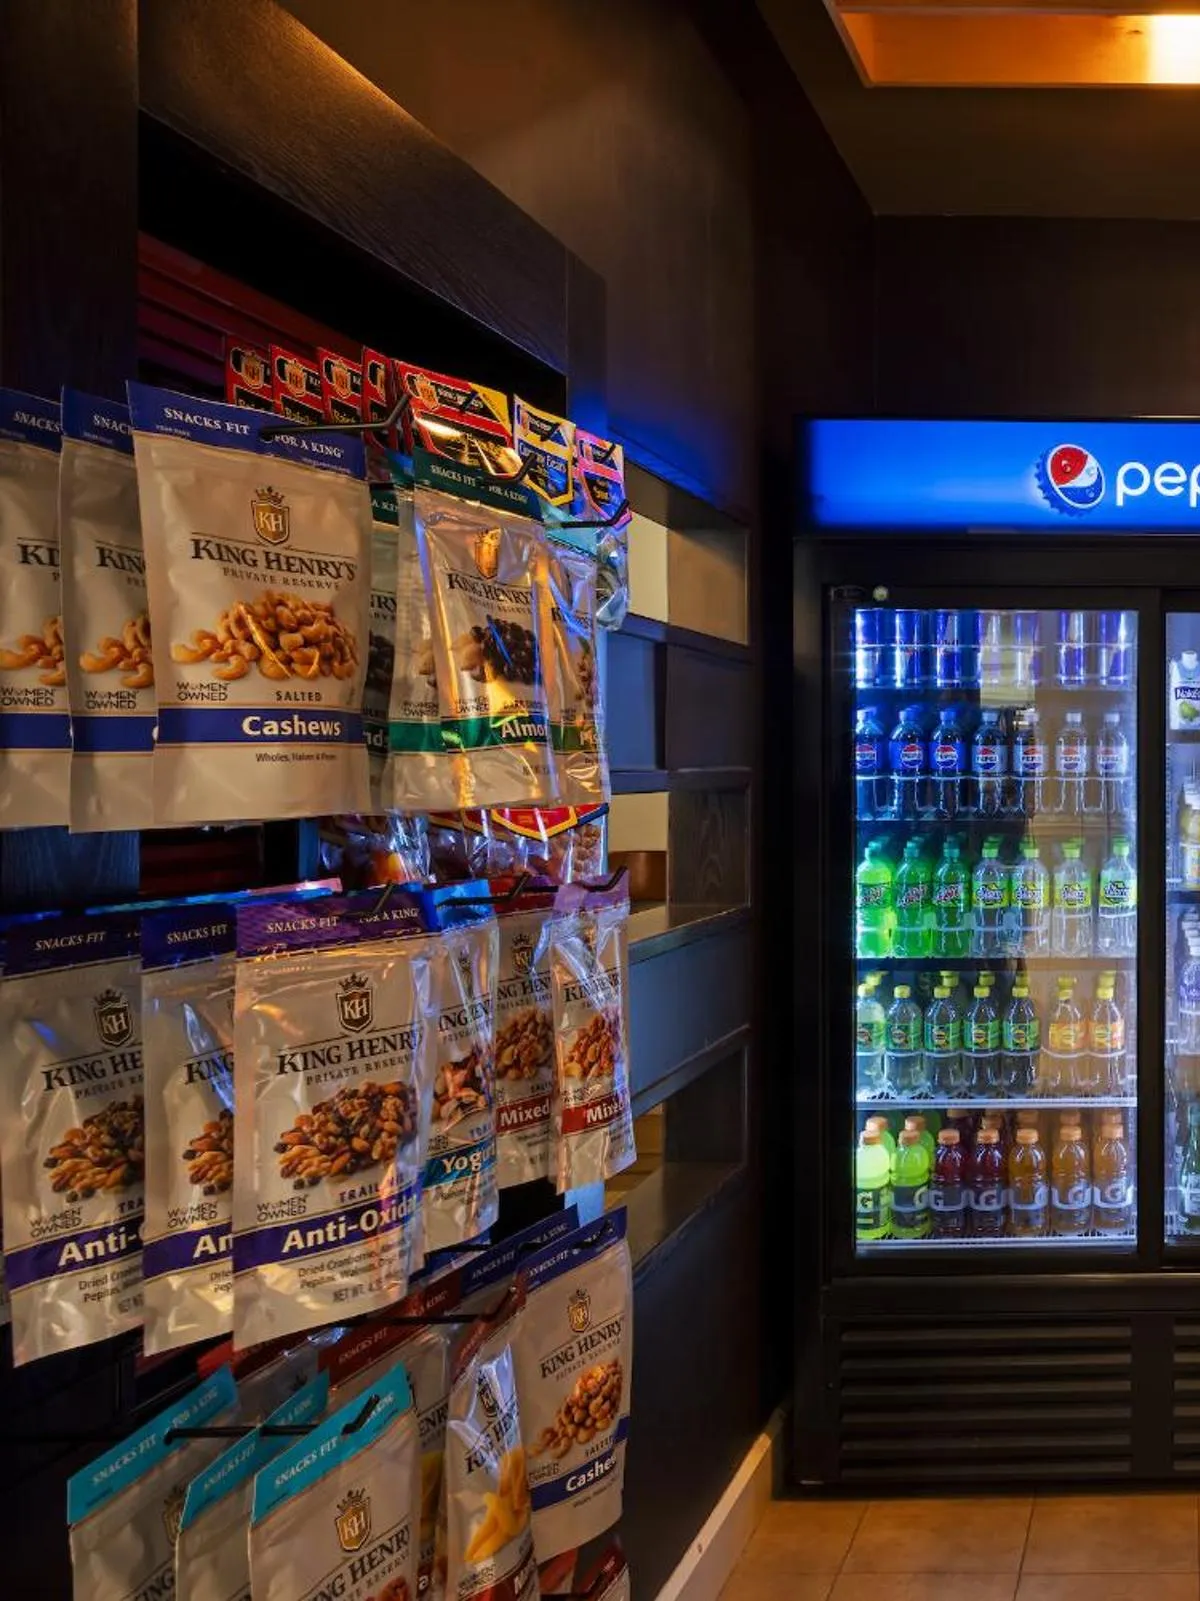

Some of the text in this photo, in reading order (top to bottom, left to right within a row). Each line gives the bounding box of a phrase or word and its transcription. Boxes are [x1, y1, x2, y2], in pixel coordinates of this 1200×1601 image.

[13, 410, 60, 433] SNACKS
[163, 407, 222, 430] SNACKS
[225, 421, 250, 435] FIT
[301, 440, 309, 450] A
[311, 442, 343, 459] KING
[430, 465, 461, 482] SNACKS
[259, 512, 283, 532] KH
[18, 544, 60, 567] KI
[191, 538, 358, 582] KING HENRY'S
[223, 567, 342, 590] PRIVATE RESERVE
[85, 699, 138, 710] OWNED
[177, 690, 228, 702] OWNED
[275, 690, 323, 701] SALTED
[242, 715, 341, 737] Cashews
[167, 923, 229, 944] SNACKS FIT
[266, 917, 316, 934] SNACKS
[319, 915, 339, 928] FIT
[35, 931, 107, 950] SNACKS FIT
[343, 998, 367, 1020] KH
[102, 1012, 127, 1035] KH
[42, 1050, 143, 1092] KING HE
[275, 1044, 341, 1076] KING
[306, 1065, 360, 1085] PRIVATE
[500, 1102, 550, 1127] Mixed
[339, 1185, 379, 1203] TRAIL
[256, 1205, 307, 1223] OWNED
[281, 1194, 417, 1253] Anti-Oxid
[193, 1234, 233, 1258] An
[540, 1350, 576, 1379] KING
[91, 1450, 139, 1485] SNACKS
[274, 1437, 339, 1489] SNACKS FIT
[343, 1513, 366, 1540] KH
